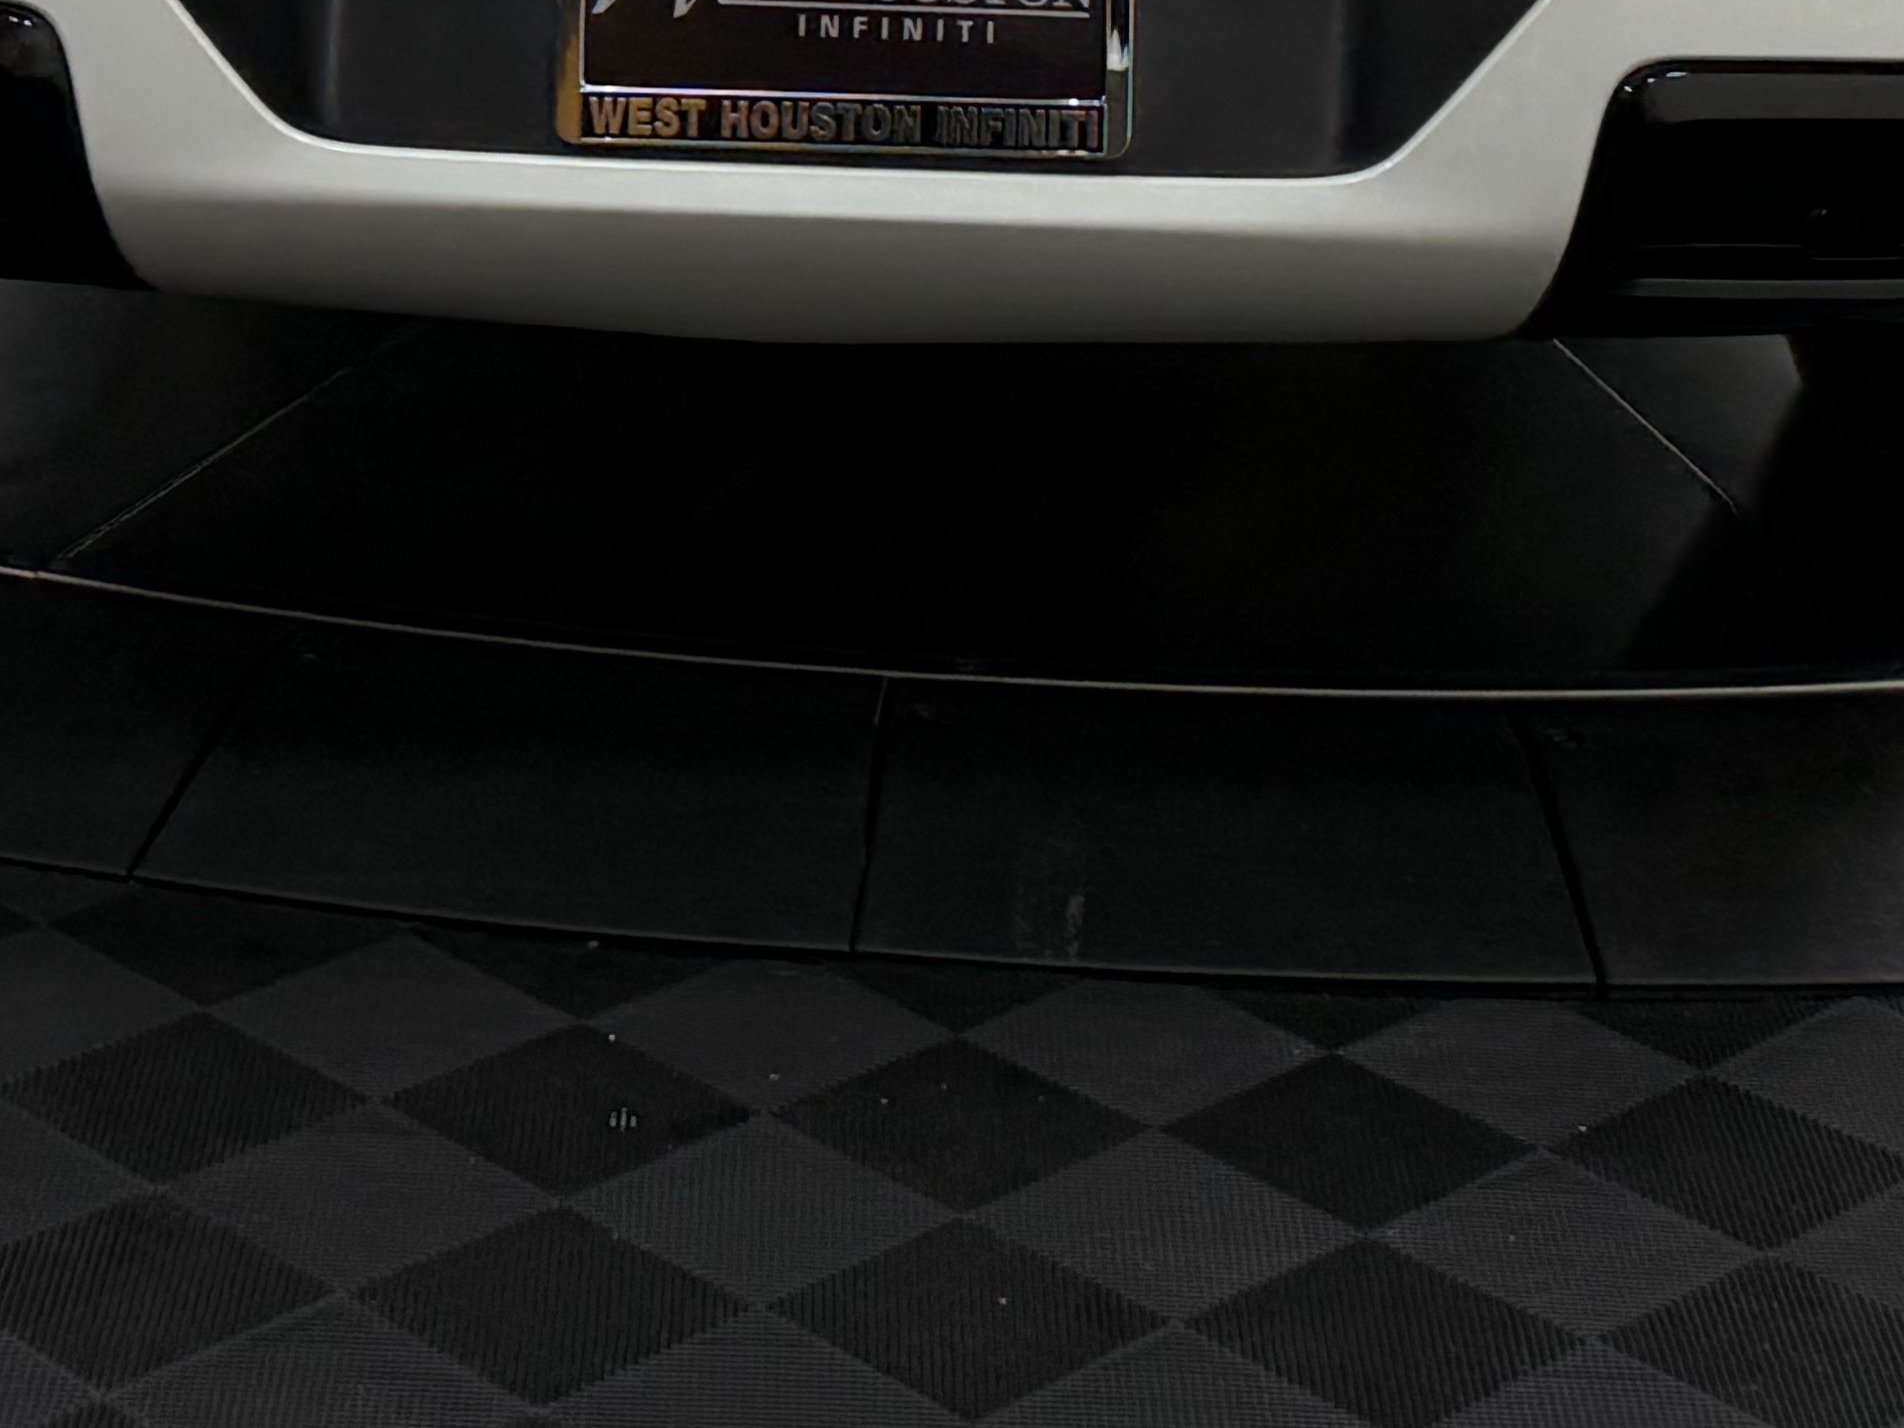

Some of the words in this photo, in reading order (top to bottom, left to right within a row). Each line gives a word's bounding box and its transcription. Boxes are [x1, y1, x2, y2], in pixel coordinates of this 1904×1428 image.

[797, 13, 997, 45] INFINITI
[589, 96, 707, 138] WEST
[720, 99, 923, 145] HOUSTON
[935, 106, 1099, 150] INFINITI
